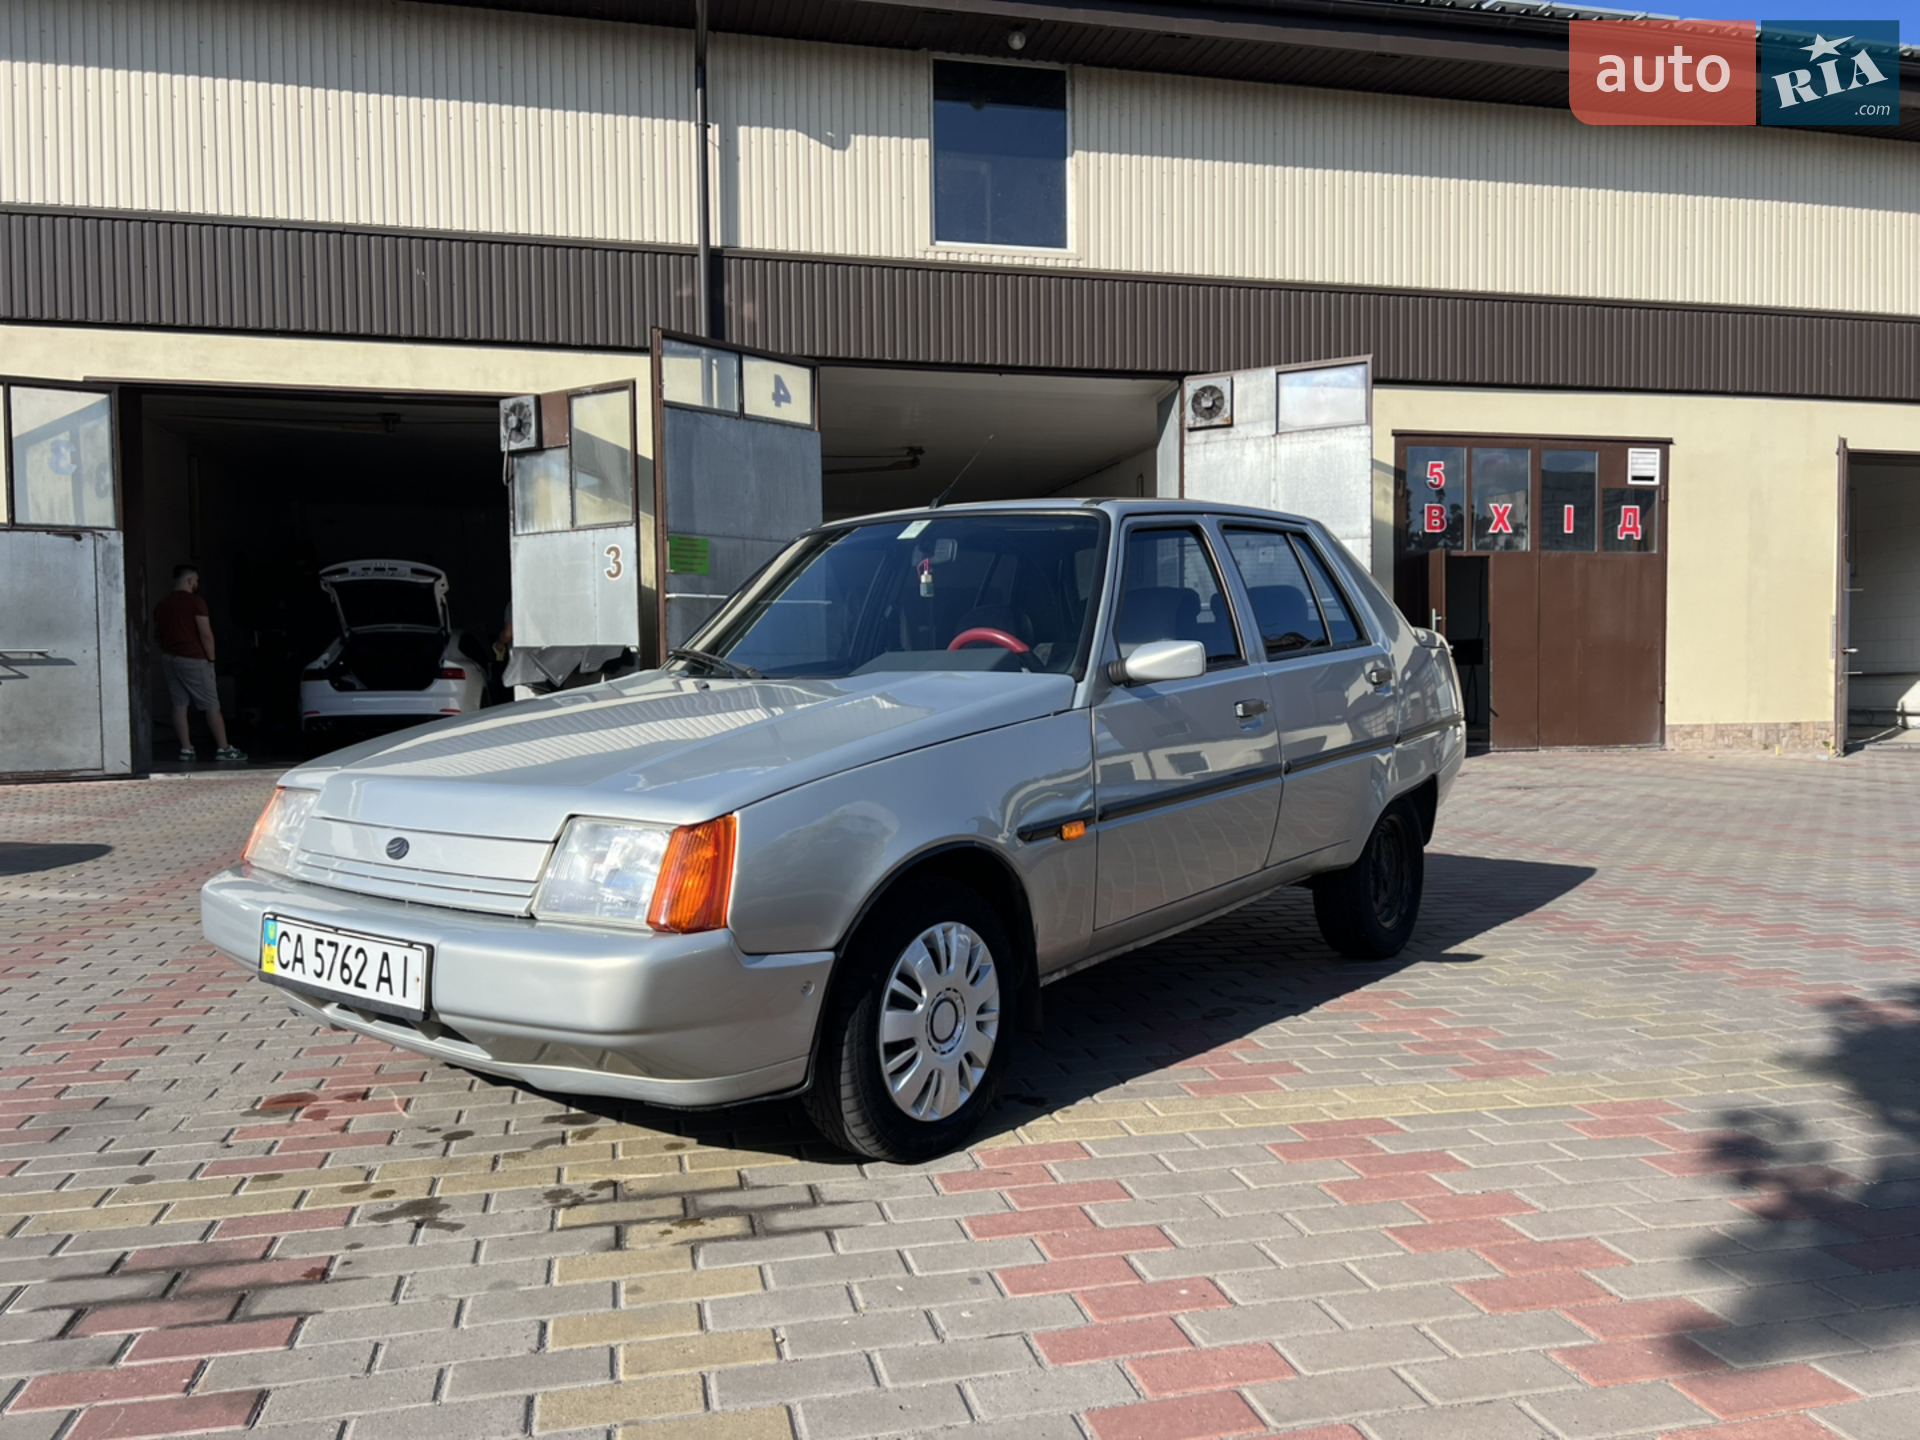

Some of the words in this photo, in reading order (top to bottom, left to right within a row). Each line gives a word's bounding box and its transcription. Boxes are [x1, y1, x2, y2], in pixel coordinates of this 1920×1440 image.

[1426, 461, 1446, 489] 5
[604, 544, 624, 580] 3
[277, 930, 306, 975] CA
[313, 938, 368, 990] 5762
[376, 951, 408, 998] AI
